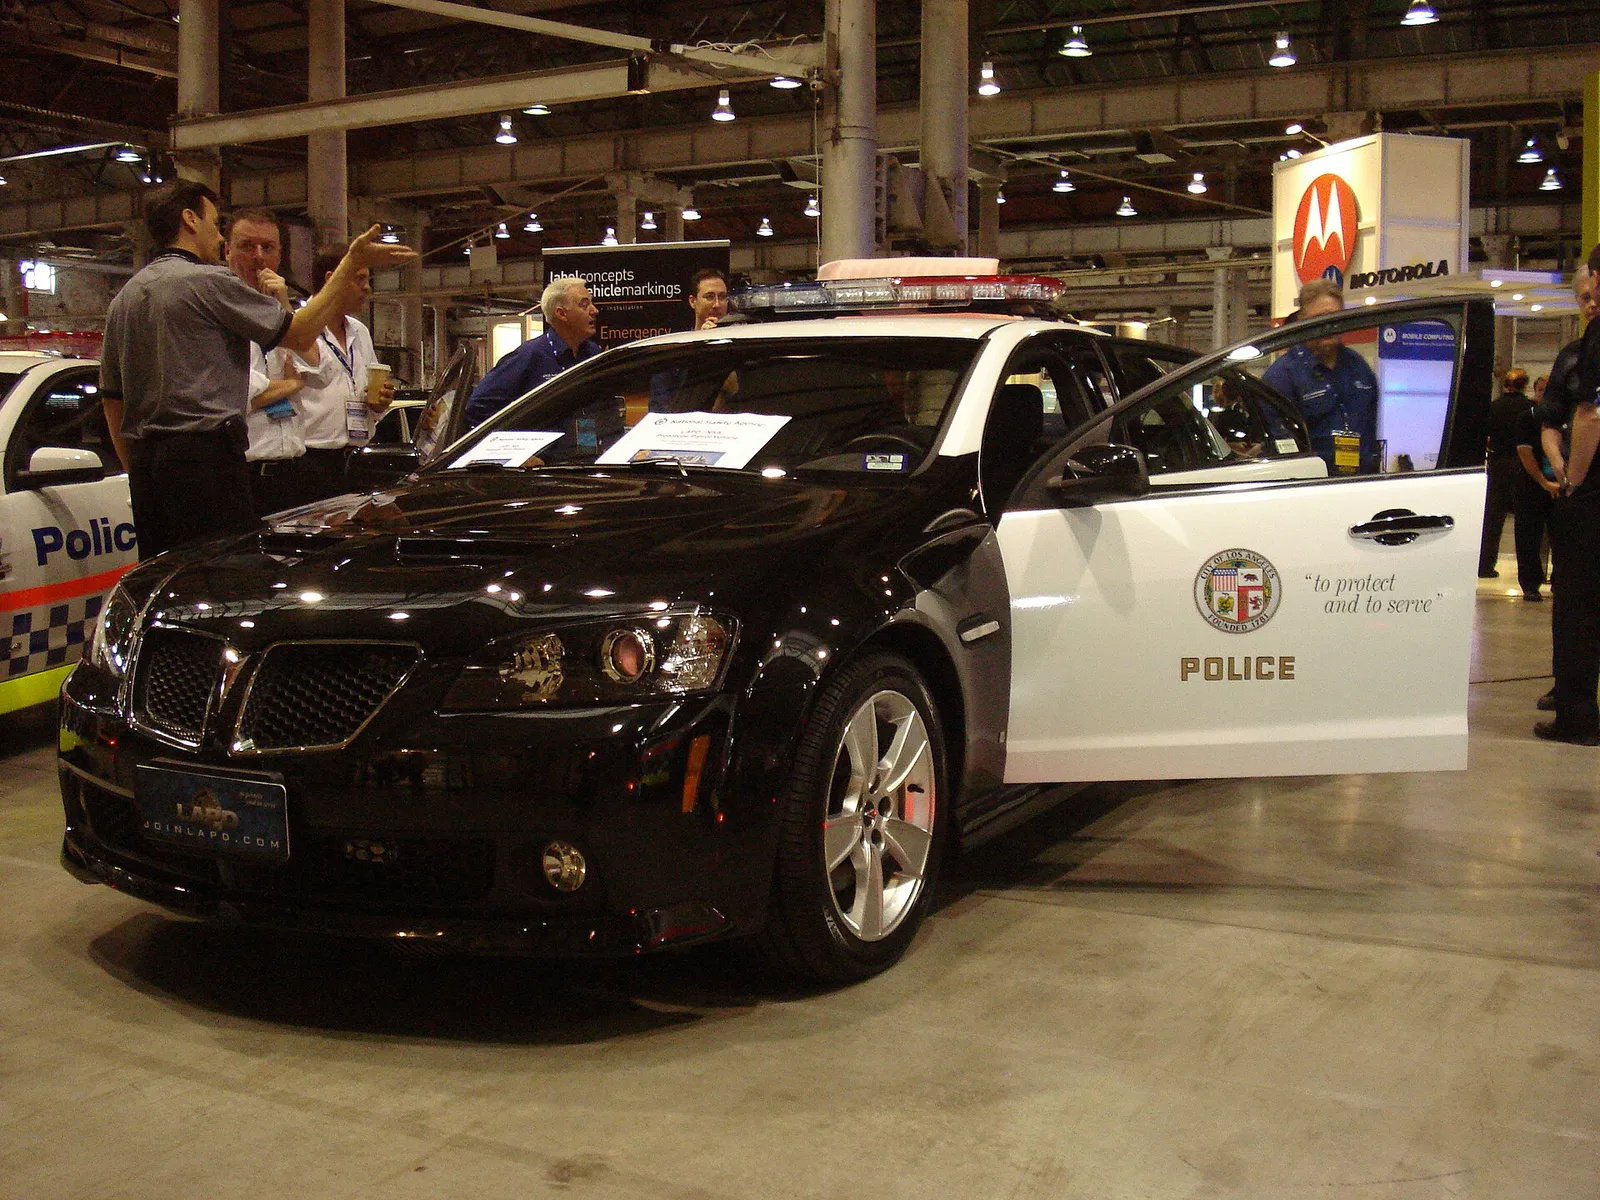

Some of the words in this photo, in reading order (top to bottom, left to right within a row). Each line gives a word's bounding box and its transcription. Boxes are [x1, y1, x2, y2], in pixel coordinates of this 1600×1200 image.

[1349, 260, 1449, 289] MOTOROLA
[587, 281, 681, 299] ehiclemarkings
[31, 517, 137, 566] Polic
[1200, 562, 1215, 580] CITY
[1226, 551, 1243, 560] LOS
[1245, 552, 1275, 580] ANGELES
[1335, 574, 1396, 596] protect
[1324, 594, 1360, 613] and
[1366, 595, 1382, 613] to
[1207, 613, 1248, 632] FOUNDED
[1181, 656, 1296, 681] POLICE
[143, 820, 280, 849] JOINLAPD.COM
